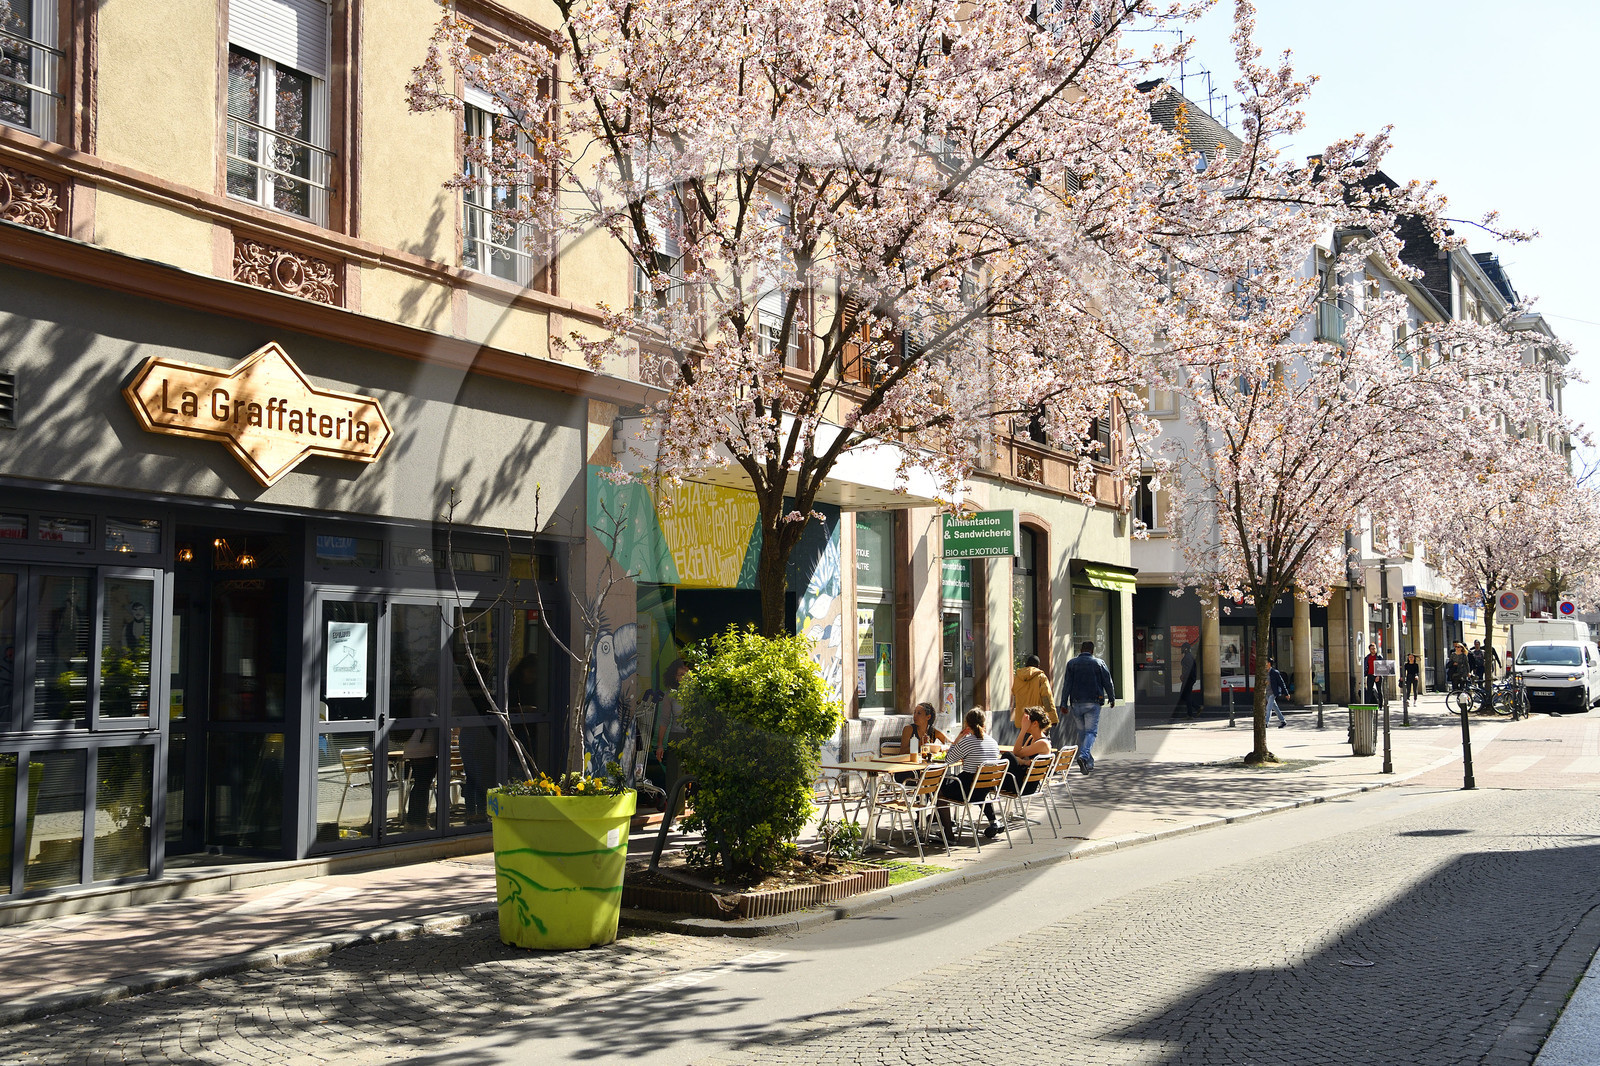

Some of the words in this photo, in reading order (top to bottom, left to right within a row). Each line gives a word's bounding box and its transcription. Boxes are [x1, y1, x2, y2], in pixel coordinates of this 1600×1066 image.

[161, 378, 199, 418] La
[211, 388, 370, 444] Graffateria
[946, 517, 1001, 528] Alimentation
[943, 530, 952, 540] &
[954, 529, 1012, 539] Sandwicherie
[945, 549, 959, 557] BIO
[969, 547, 1009, 556] EXOTIQUE
